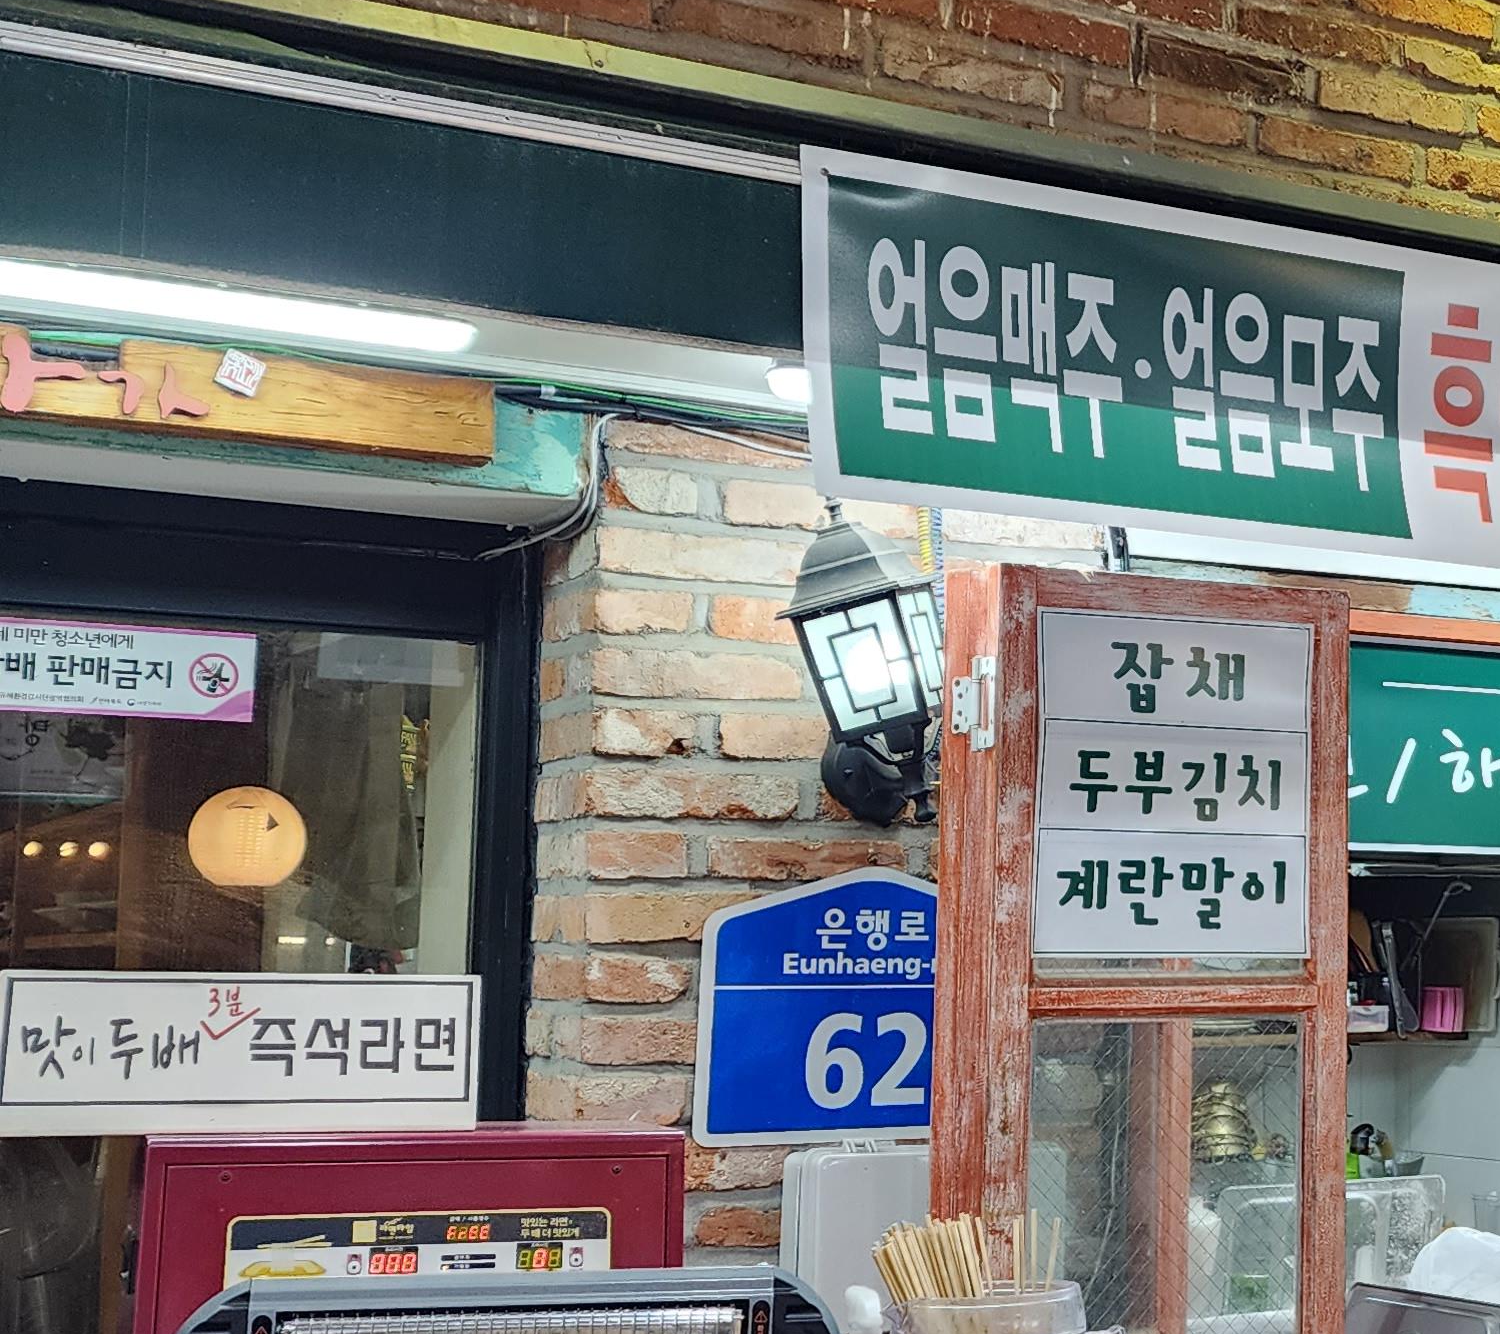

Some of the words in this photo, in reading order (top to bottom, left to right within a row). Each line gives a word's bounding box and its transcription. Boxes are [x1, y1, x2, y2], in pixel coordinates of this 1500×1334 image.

[14, 628, 48, 646] 미만
[51, 629, 134, 650] 청소년에게
[0, 651, 36, 681] 배
[46, 654, 174, 690] 판매금지
[1070, 750, 1281, 822] 두부김치
[1057, 857, 1287, 931] 계란말이
[816, 908, 929, 951] 은행로
[208, 986, 244, 1017] 3분
[21, 1015, 94, 1080] 맛이
[249, 1017, 457, 1077] 즉석라면
[805, 1012, 927, 1110] 62
